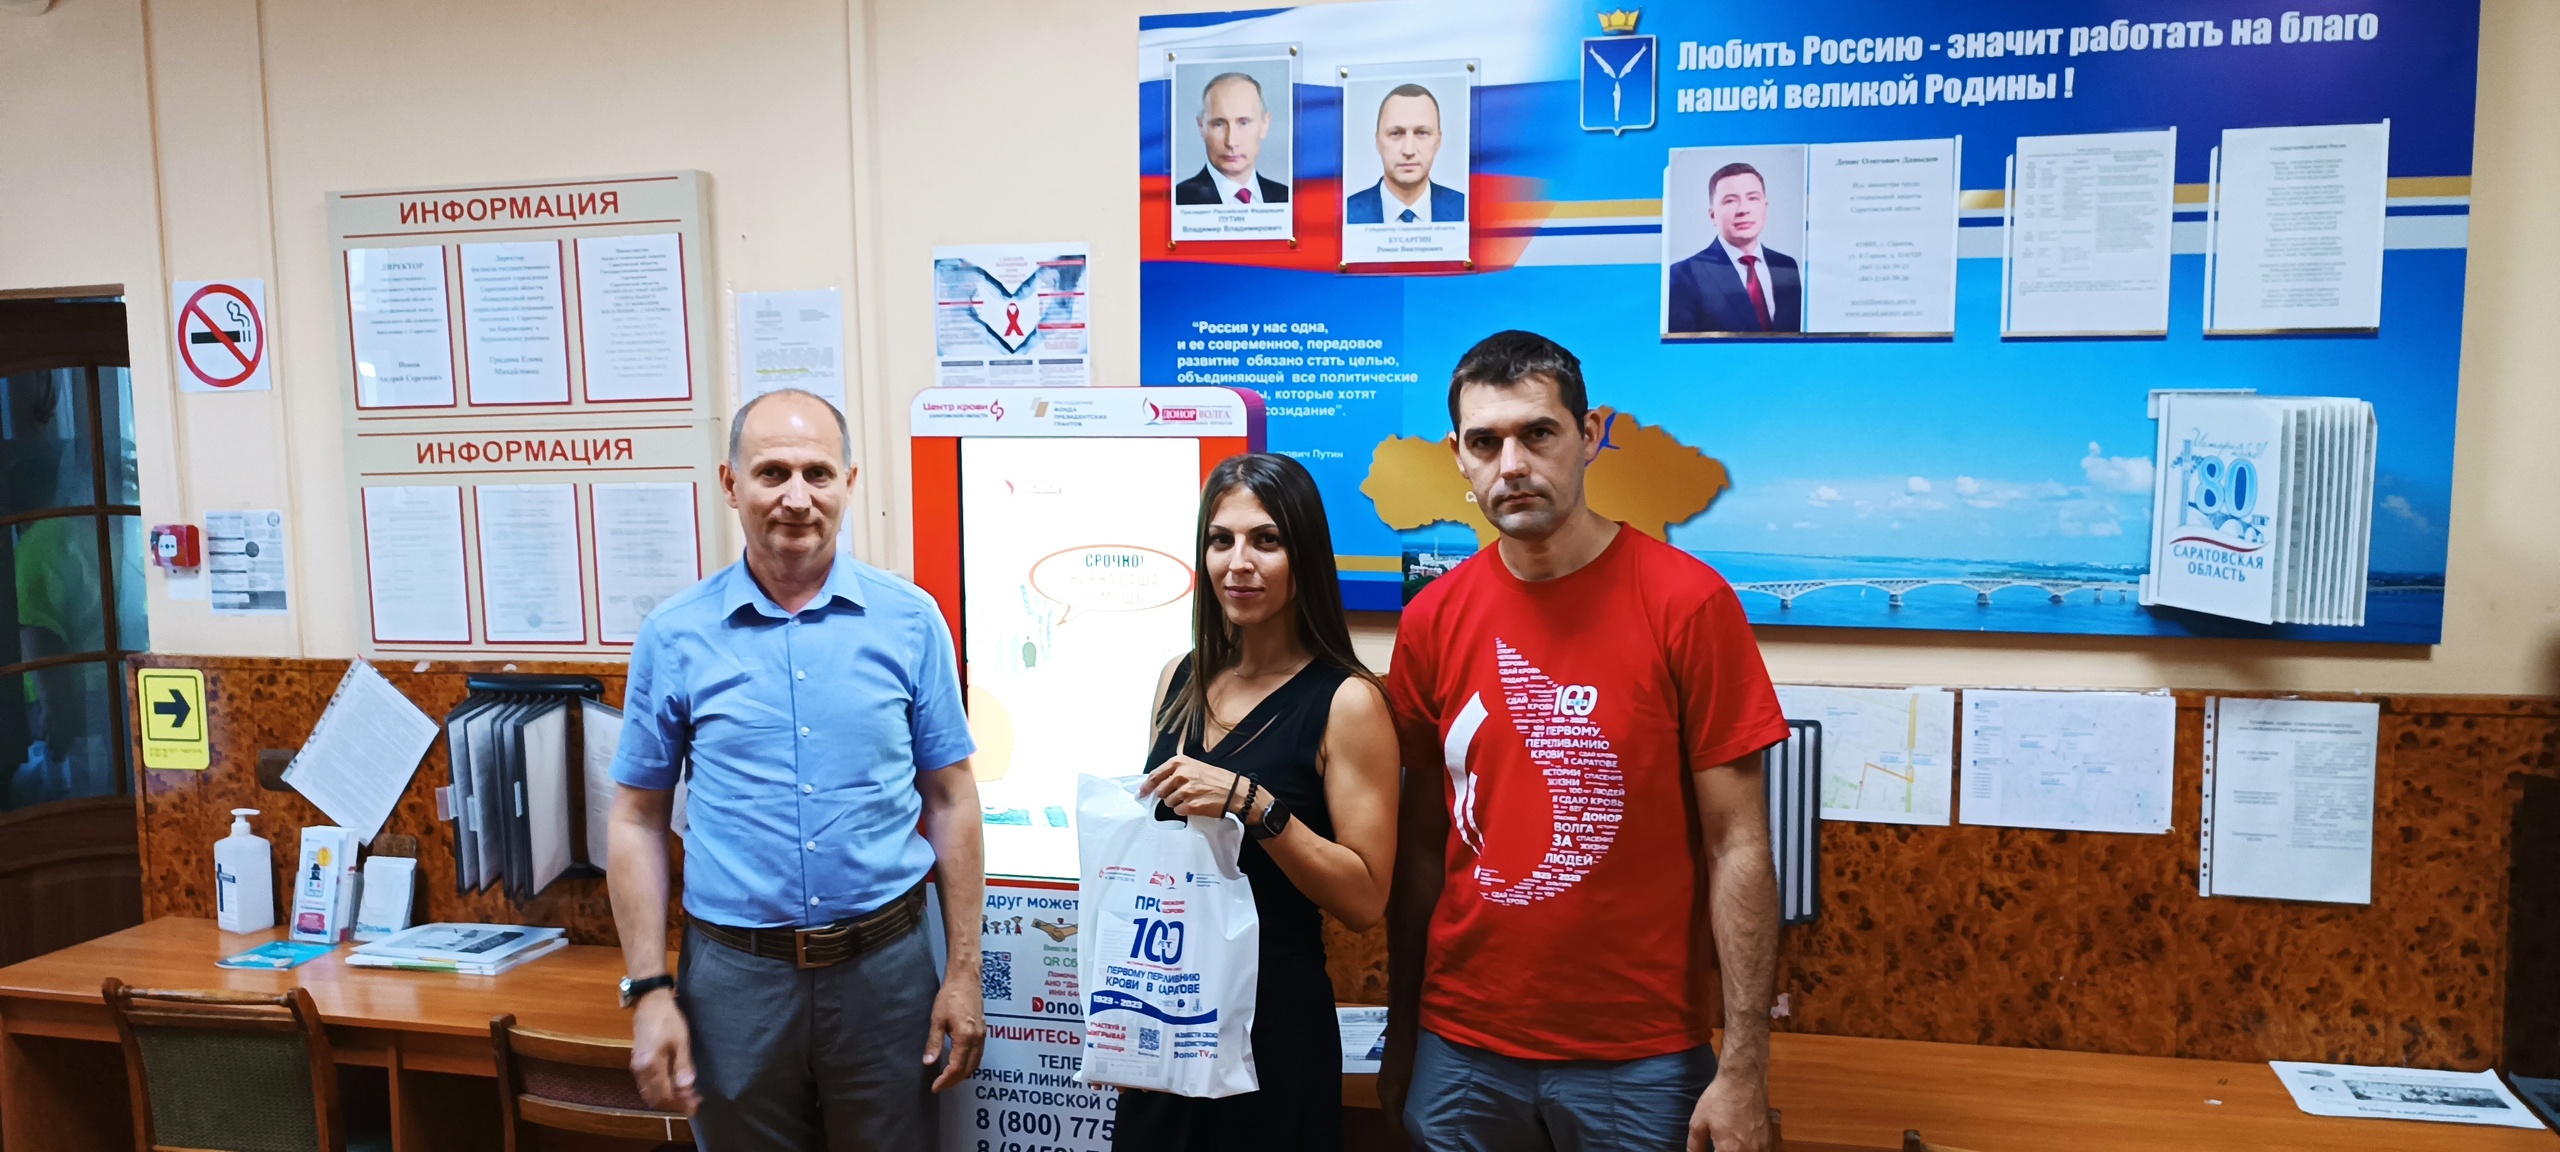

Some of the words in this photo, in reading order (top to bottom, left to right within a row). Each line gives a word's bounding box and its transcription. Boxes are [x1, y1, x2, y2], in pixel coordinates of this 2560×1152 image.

[1677, 39, 1796, 71] Любить
[1802, 35, 1924, 66] Россию
[1947, 27, 2064, 59] значит
[2069, 19, 2224, 57] работать
[2231, 18, 2272, 46] на
[2280, 11, 2379, 44] благо
[1677, 78, 1778, 113] нашей
[1784, 73, 1919, 110] великой
[1925, 73, 2057, 107] Родины
[399, 191, 620, 224] ИНФОРМАЦИЯ
[1252, 323, 1260, 336] у
[1264, 323, 1287, 333] нас
[1291, 323, 1328, 335] одна,
[1177, 341, 1186, 350] и
[1189, 341, 1205, 350] ее
[1208, 340, 1303, 352] современное,
[1307, 339, 1383, 352] передовое
[1177, 356, 1239, 369] развитие
[1247, 354, 1304, 366] обязано
[1307, 356, 1345, 366] стать
[1349, 355, 1400, 368] целью,
[1177, 371, 1284, 384] объединяющей
[1292, 372, 1316, 383] все
[1320, 372, 1418, 383] политические
[1256, 388, 1271, 402] ы,
[1275, 389, 1334, 402] которые
[1338, 390, 1377, 400] хотят
[923, 403, 954, 412] Центр
[956, 404, 988, 412] крови
[1163, 410, 1196, 419] ДОНОР
[1199, 410, 1230, 419] ВОЛГА
[416, 438, 634, 465] ИНФОРМАЦИЯ
[1276, 451, 1311, 460] рович
[1313, 450, 1343, 459] Путин
[2195, 455, 2258, 519] 80
[1085, 554, 1144, 568] СРОЧНО!
[2173, 544, 2264, 570] САРАТОВСКАЯ
[2187, 562, 2246, 583] ОБЛАСТЬ
[1553, 685, 1598, 716] 100
[1546, 726, 1601, 737] ПЕРВОМУ
[1530, 750, 1565, 758] КРОВИ
[1570, 758, 1618, 768] САРАТОВЕ
[1559, 796, 1588, 804] СДАЮ
[1590, 797, 1624, 807] КРОВЬ
[1582, 812, 1622, 822] ДОНОР
[1553, 821, 1594, 833] ВОЛГА
[1552, 833, 1573, 847] ЗА
[1544, 853, 1593, 866] ЛЮДЕЙ
[986, 894, 1023, 910] друг
[1027, 897, 1080, 910] может
[1130, 918, 1184, 965] 100
[1043, 956, 1061, 967] QR
[1107, 965, 1145, 979] ПЕРВОМУ
[1044, 979, 1061, 988] АНО
[1105, 976, 1139, 990] КРОВИ
[1146, 982, 1153, 992] В
[975, 1086, 1100, 1110] САРАТОВСКОЙ
[976, 1108, 990, 1130] 8
[999, 1109, 1061, 1142] (800)
